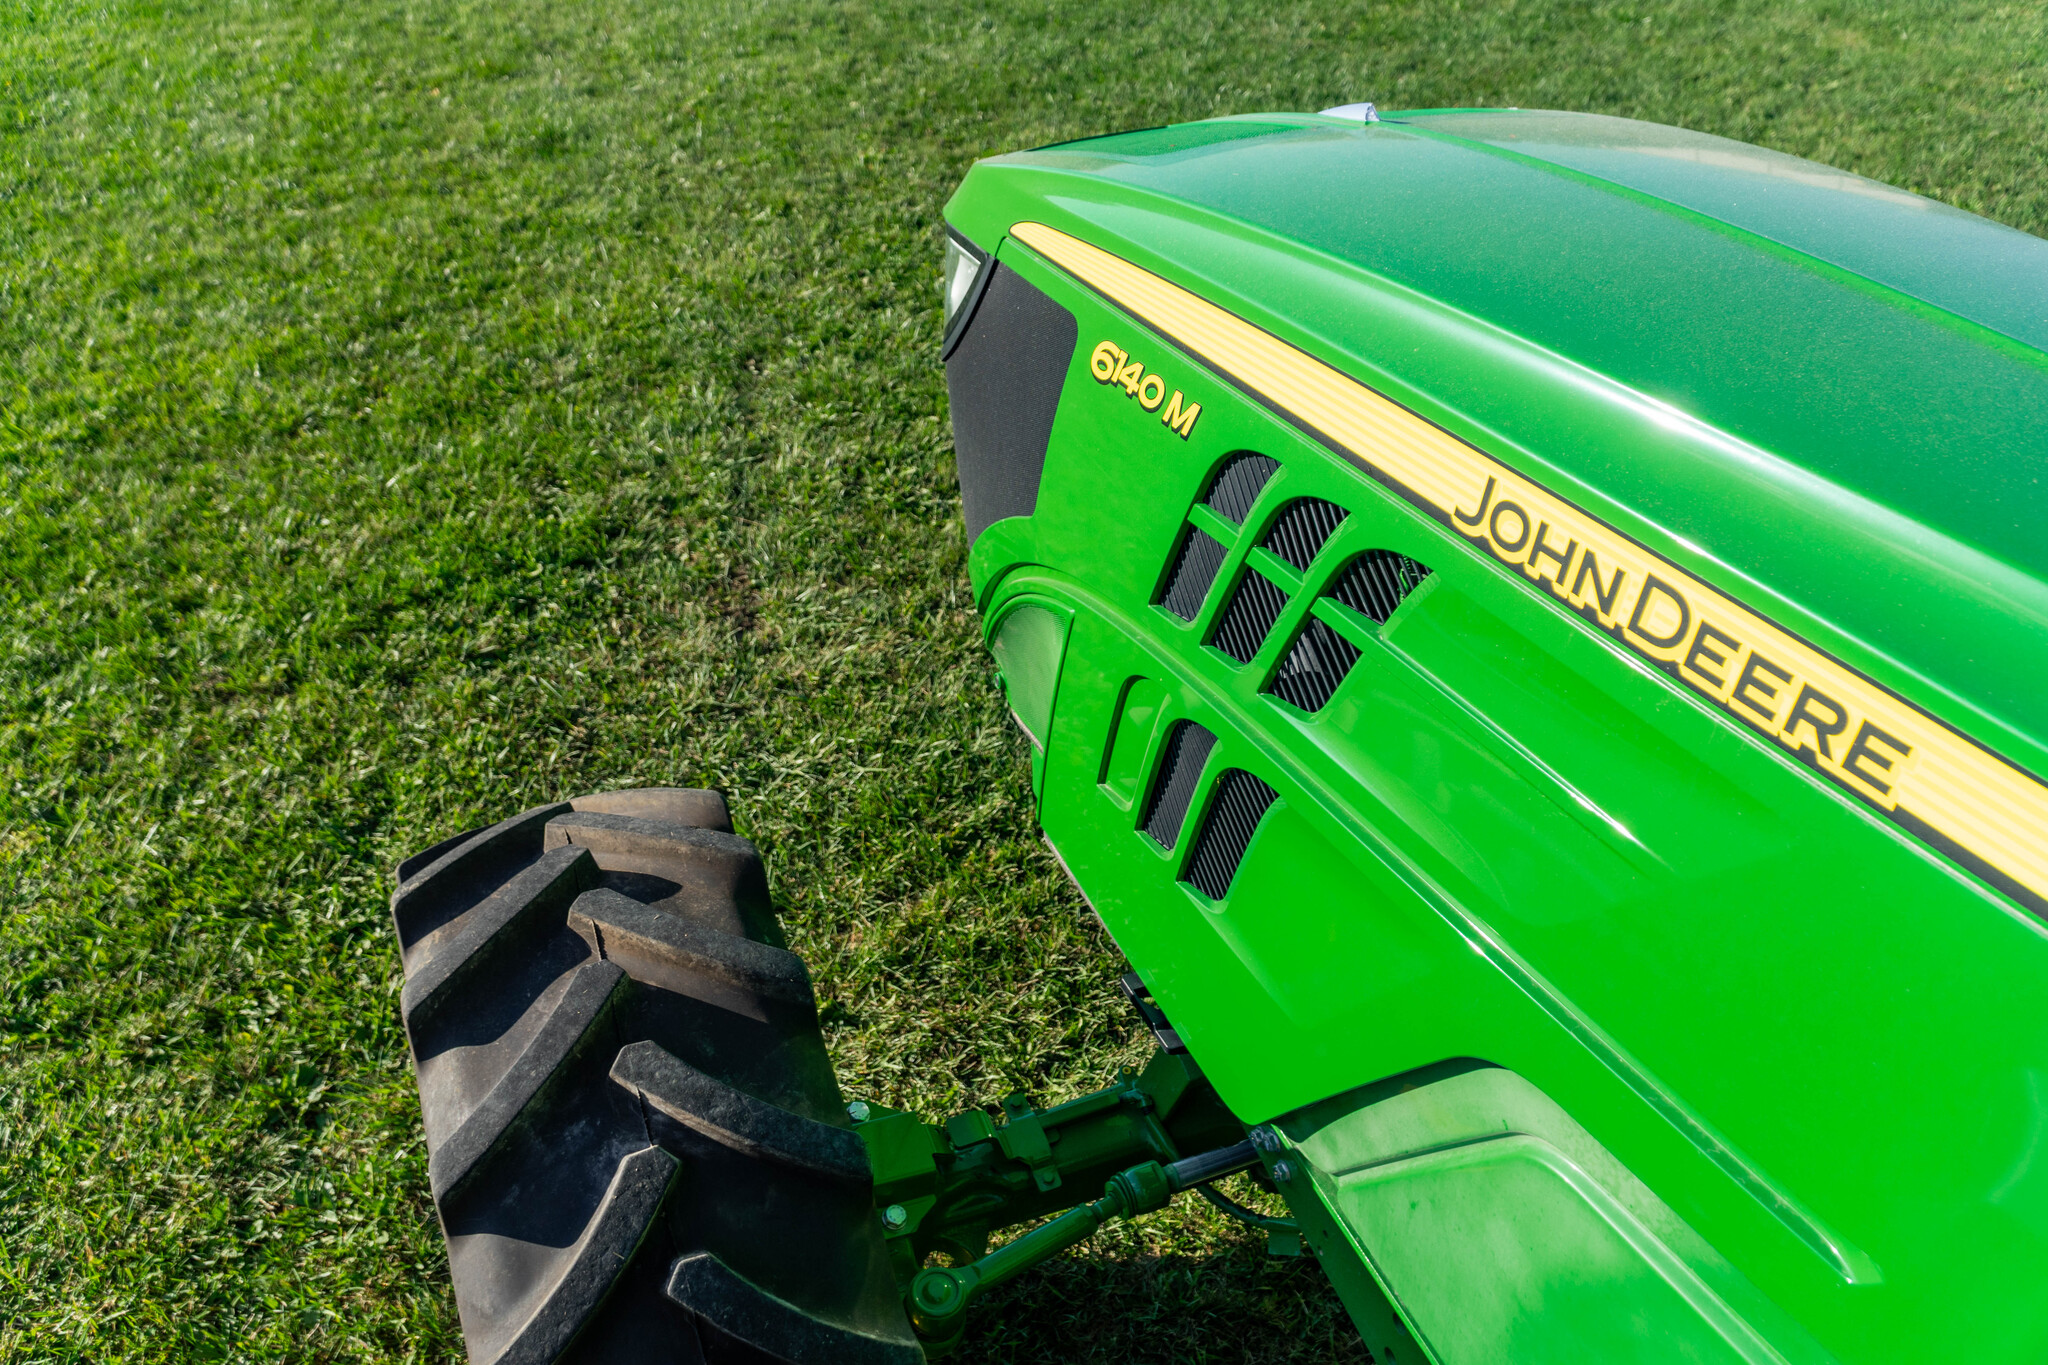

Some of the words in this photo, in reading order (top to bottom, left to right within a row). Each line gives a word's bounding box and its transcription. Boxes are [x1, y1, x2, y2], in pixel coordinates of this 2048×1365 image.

[1090, 340, 1166, 413] 6140
[1161, 389, 1202, 441] M
[1452, 475, 1626, 617] JOHN
[1626, 572, 1913, 797] DEERE
